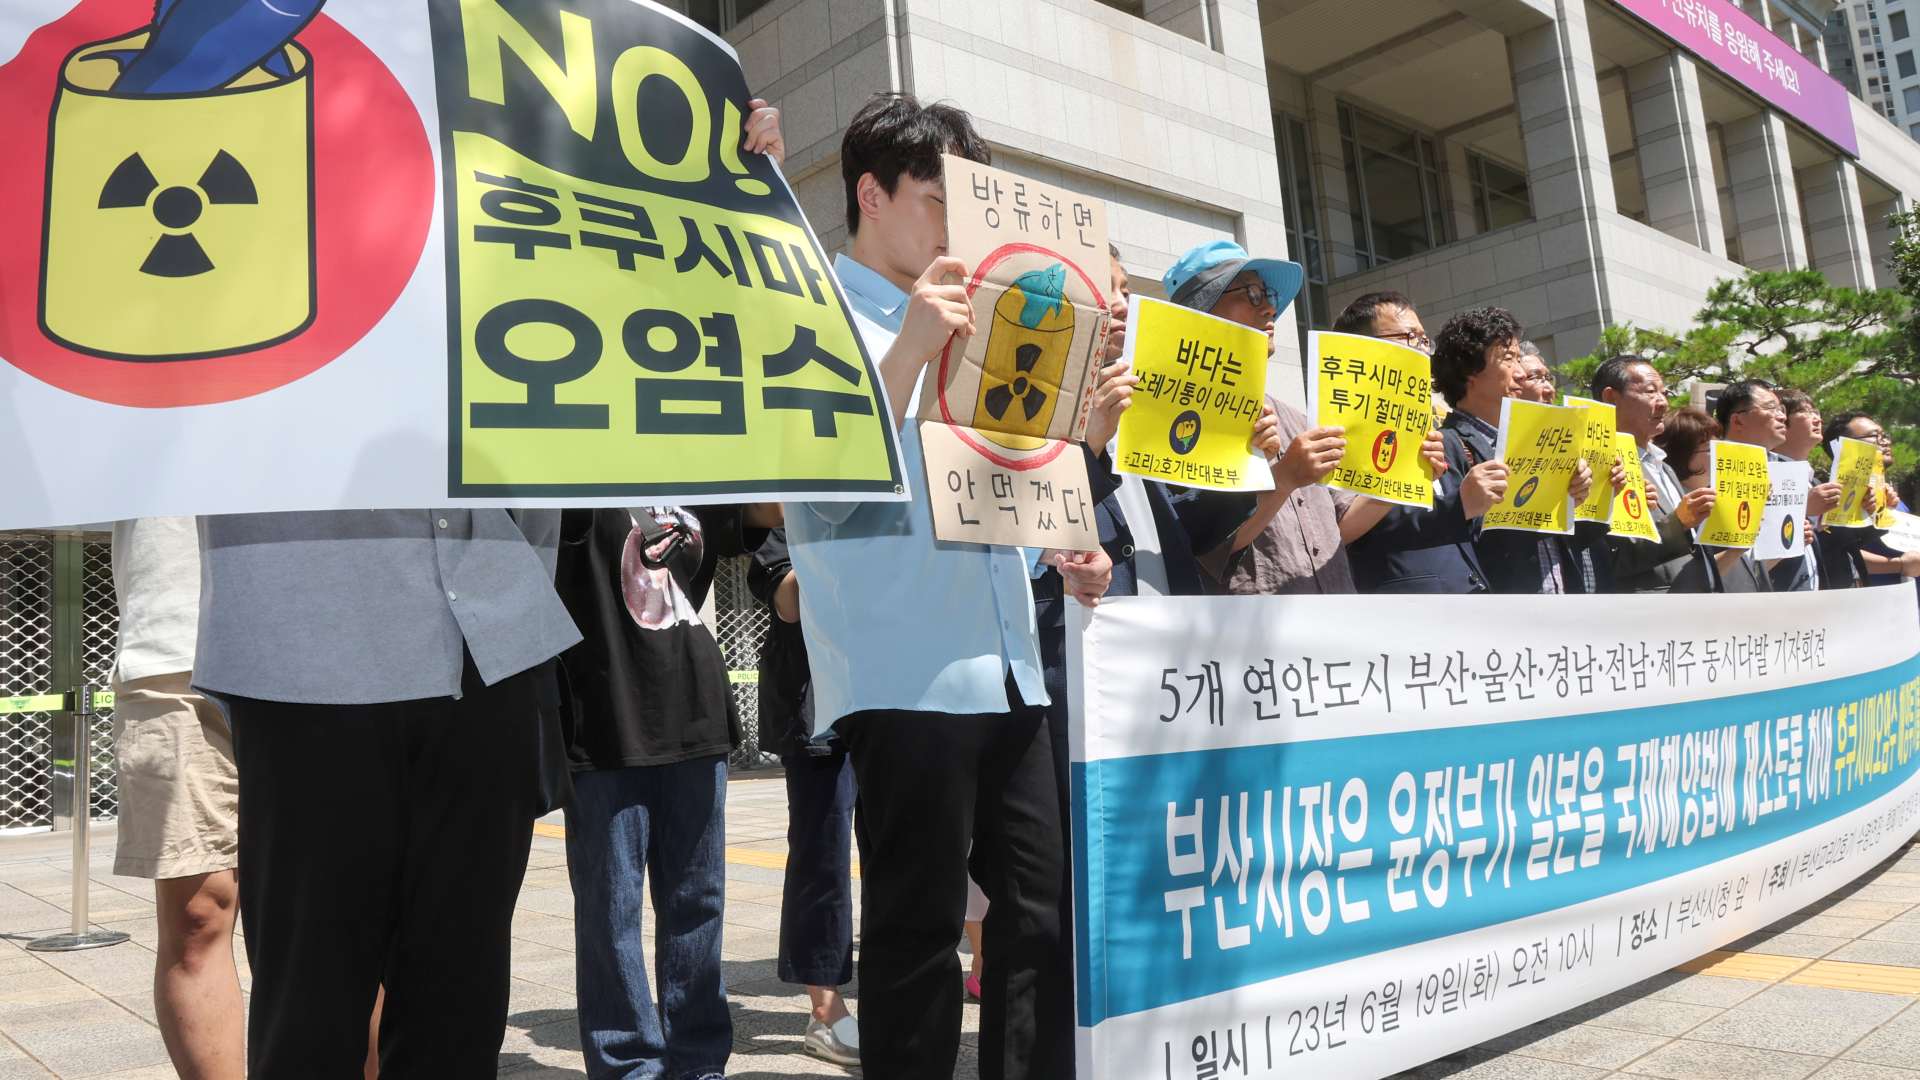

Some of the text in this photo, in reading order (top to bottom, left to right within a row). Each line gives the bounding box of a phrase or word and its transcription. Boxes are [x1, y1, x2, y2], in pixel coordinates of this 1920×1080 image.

[1724, 22, 1763, 73] 응원해
[1763, 50, 1801, 95] 주세요!
[461, 0, 771, 195] NO!
[969, 171, 1096, 248] 방류하면
[473, 168, 829, 306] 후쿠시마
[469, 299, 874, 438] 오염수
[1176, 338, 1243, 387] 바다는
[1320, 355, 1402, 395] 후쿠시마
[1133, 368, 1212, 411] 쓰레기통이
[1329, 388, 1371, 420] 투기
[1376, 397, 1404, 430] 절대
[1536, 426, 1574, 455] 바다는
[1587, 420, 1610, 448] 바다는
[1333, 467, 1426, 501] 고리2호기반대본부
[1716, 458, 1746, 477] 후쿠시마
[1718, 480, 1734, 498] 투기
[1735, 481, 1750, 499] 절대
[1159, 660, 1224, 727] 5개
[1243, 653, 1392, 722] 연안도시
[1702, 634, 1768, 684] 동시다발
[1774, 627, 1826, 670] 기자회견
[1163, 777, 1373, 961] 부산시장은
[1386, 757, 1517, 913] 윤정부가
[1526, 747, 1605, 883] 일본을
[1613, 724, 1738, 859] 국제해양법에
[1742, 712, 1805, 827] 제소토록
[1191, 1023, 1249, 1080] 일시
[1287, 993, 1348, 1057] 23년
[1360, 979, 1402, 1035] 6월
[1415, 949, 1501, 1019] 19일(화)
[1508, 936, 1549, 982] 오전
[1558, 924, 1595, 974] 10시
[1630, 902, 1659, 952] 장소
[1676, 881, 1731, 934] 부산시청
[1734, 874, 1749, 912] 앞
[1768, 860, 1791, 897] 주최
